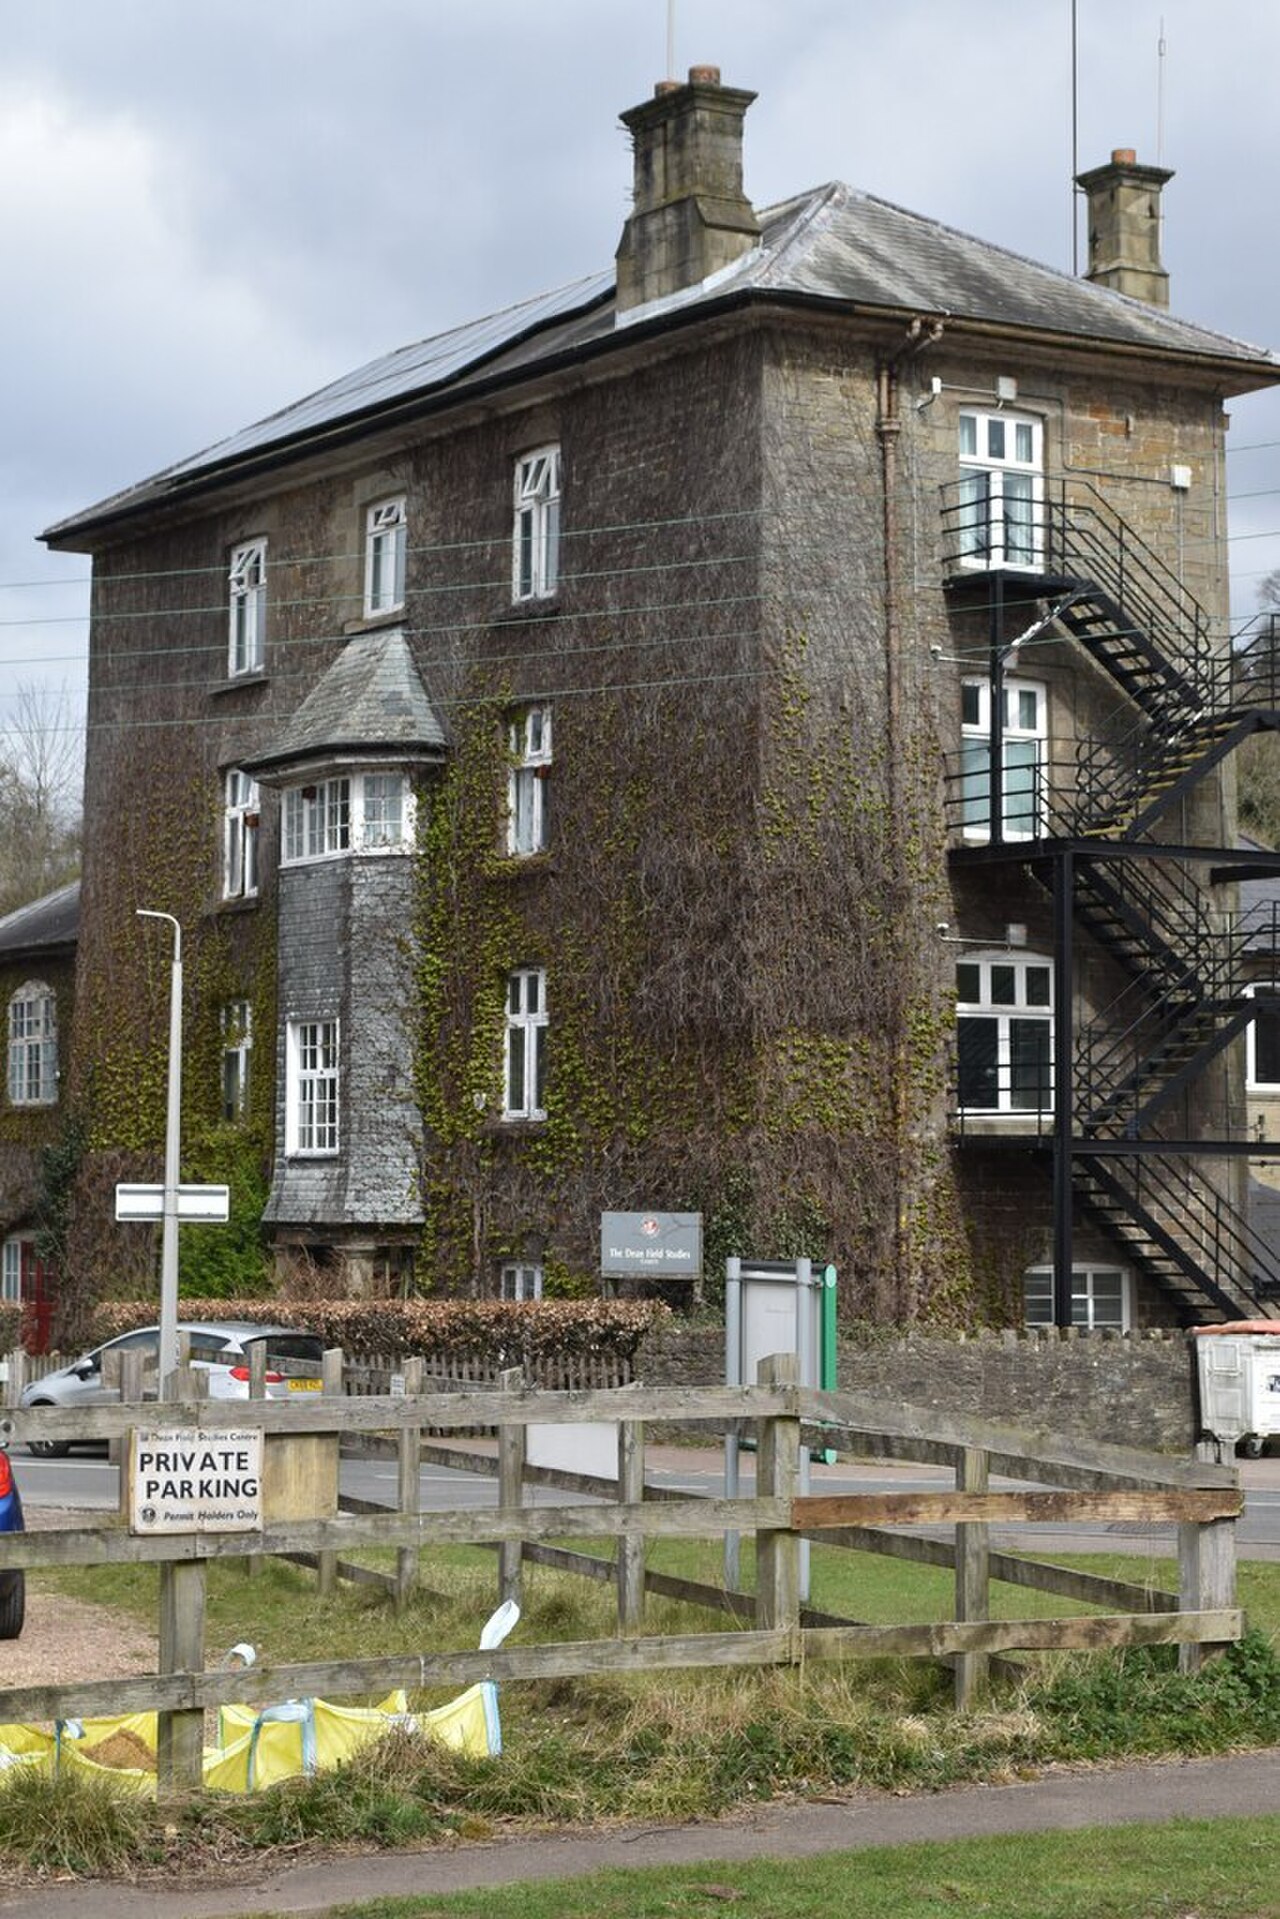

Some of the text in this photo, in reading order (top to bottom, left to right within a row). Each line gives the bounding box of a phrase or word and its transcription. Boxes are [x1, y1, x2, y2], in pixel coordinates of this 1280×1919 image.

[609, 1247, 622, 1258] The
[625, 1247, 645, 1258] Dean
[140, 1452, 249, 1472] PRIVATE
[146, 1479, 258, 1500] PARKING
[197, 1509, 234, 1521] Holders
[236, 1509, 259, 1521] Only
